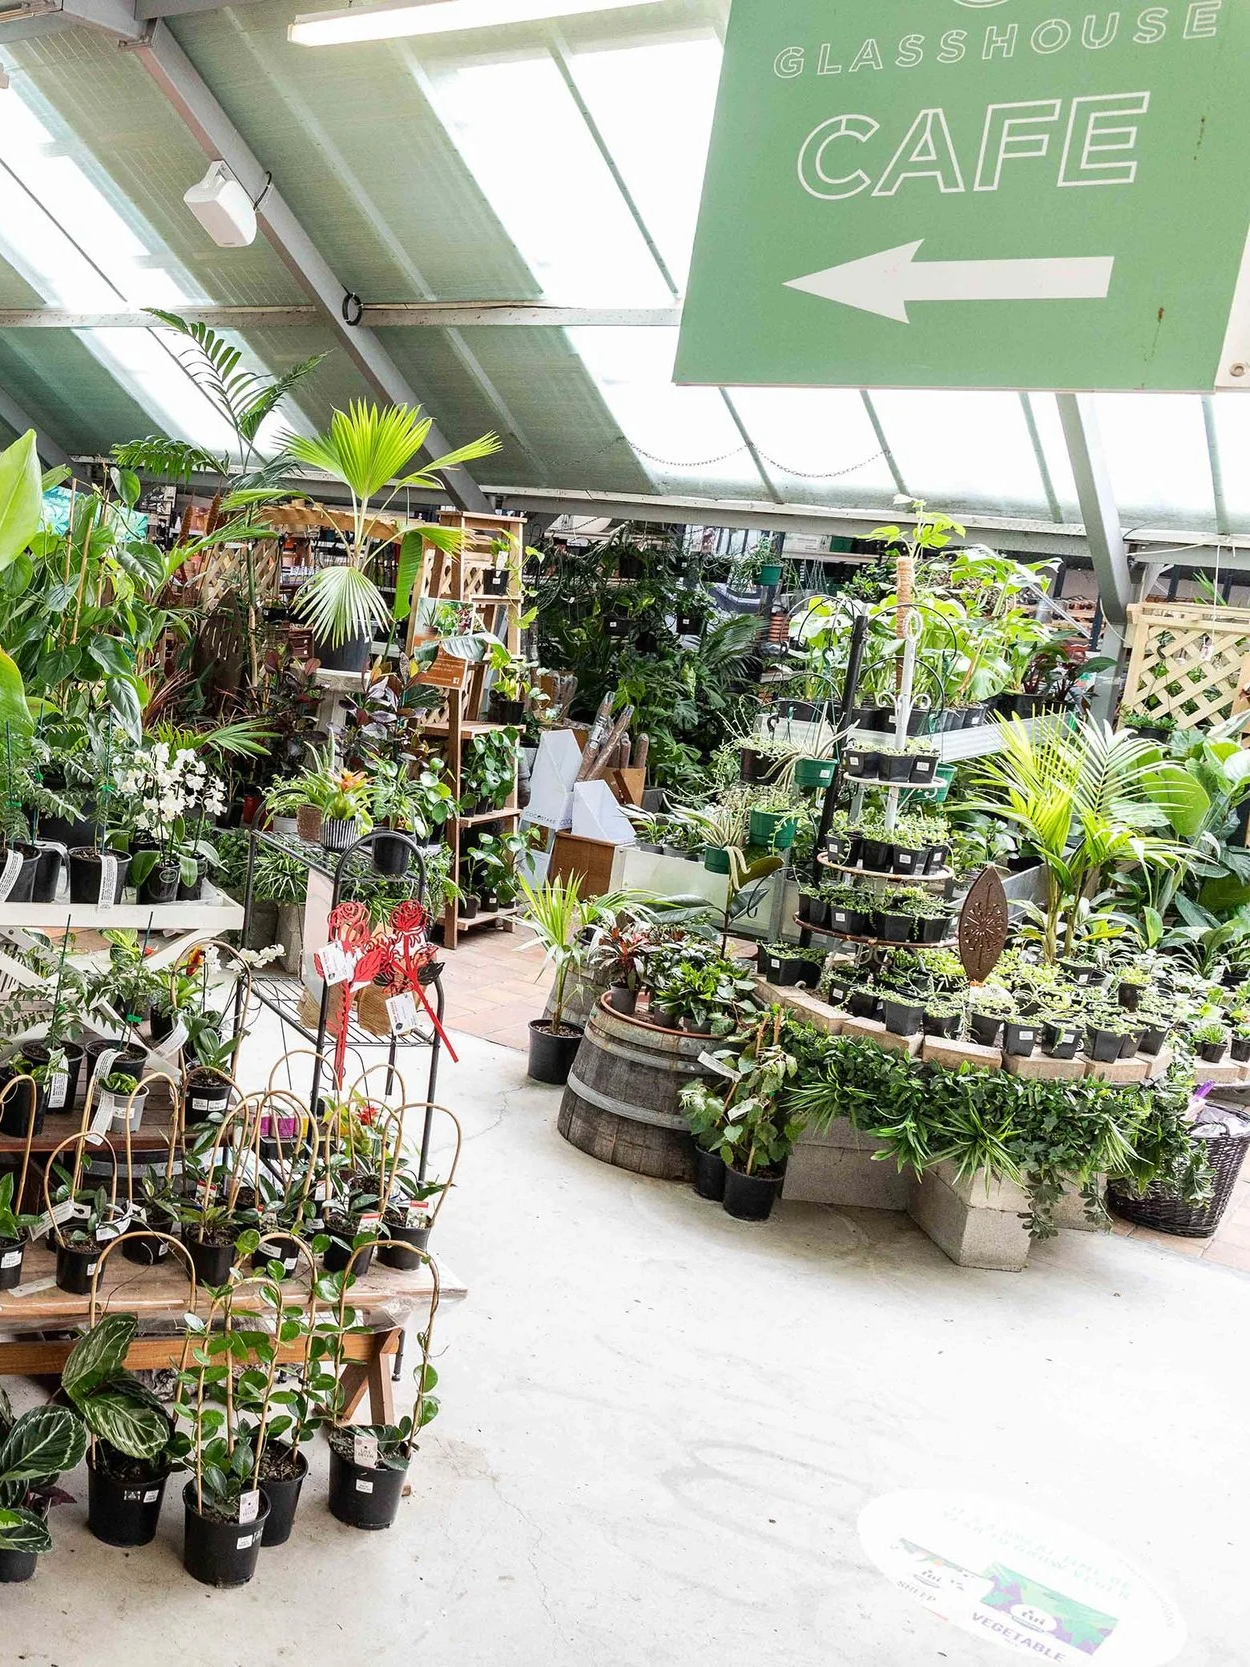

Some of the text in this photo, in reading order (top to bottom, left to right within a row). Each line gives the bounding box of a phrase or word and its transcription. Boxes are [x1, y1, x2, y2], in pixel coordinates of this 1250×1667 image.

[773, 0, 1222, 79] GLASSHOUSE
[797, 90, 1151, 200] CAFE
[972, 1611, 1067, 1664] VEGETABLE
